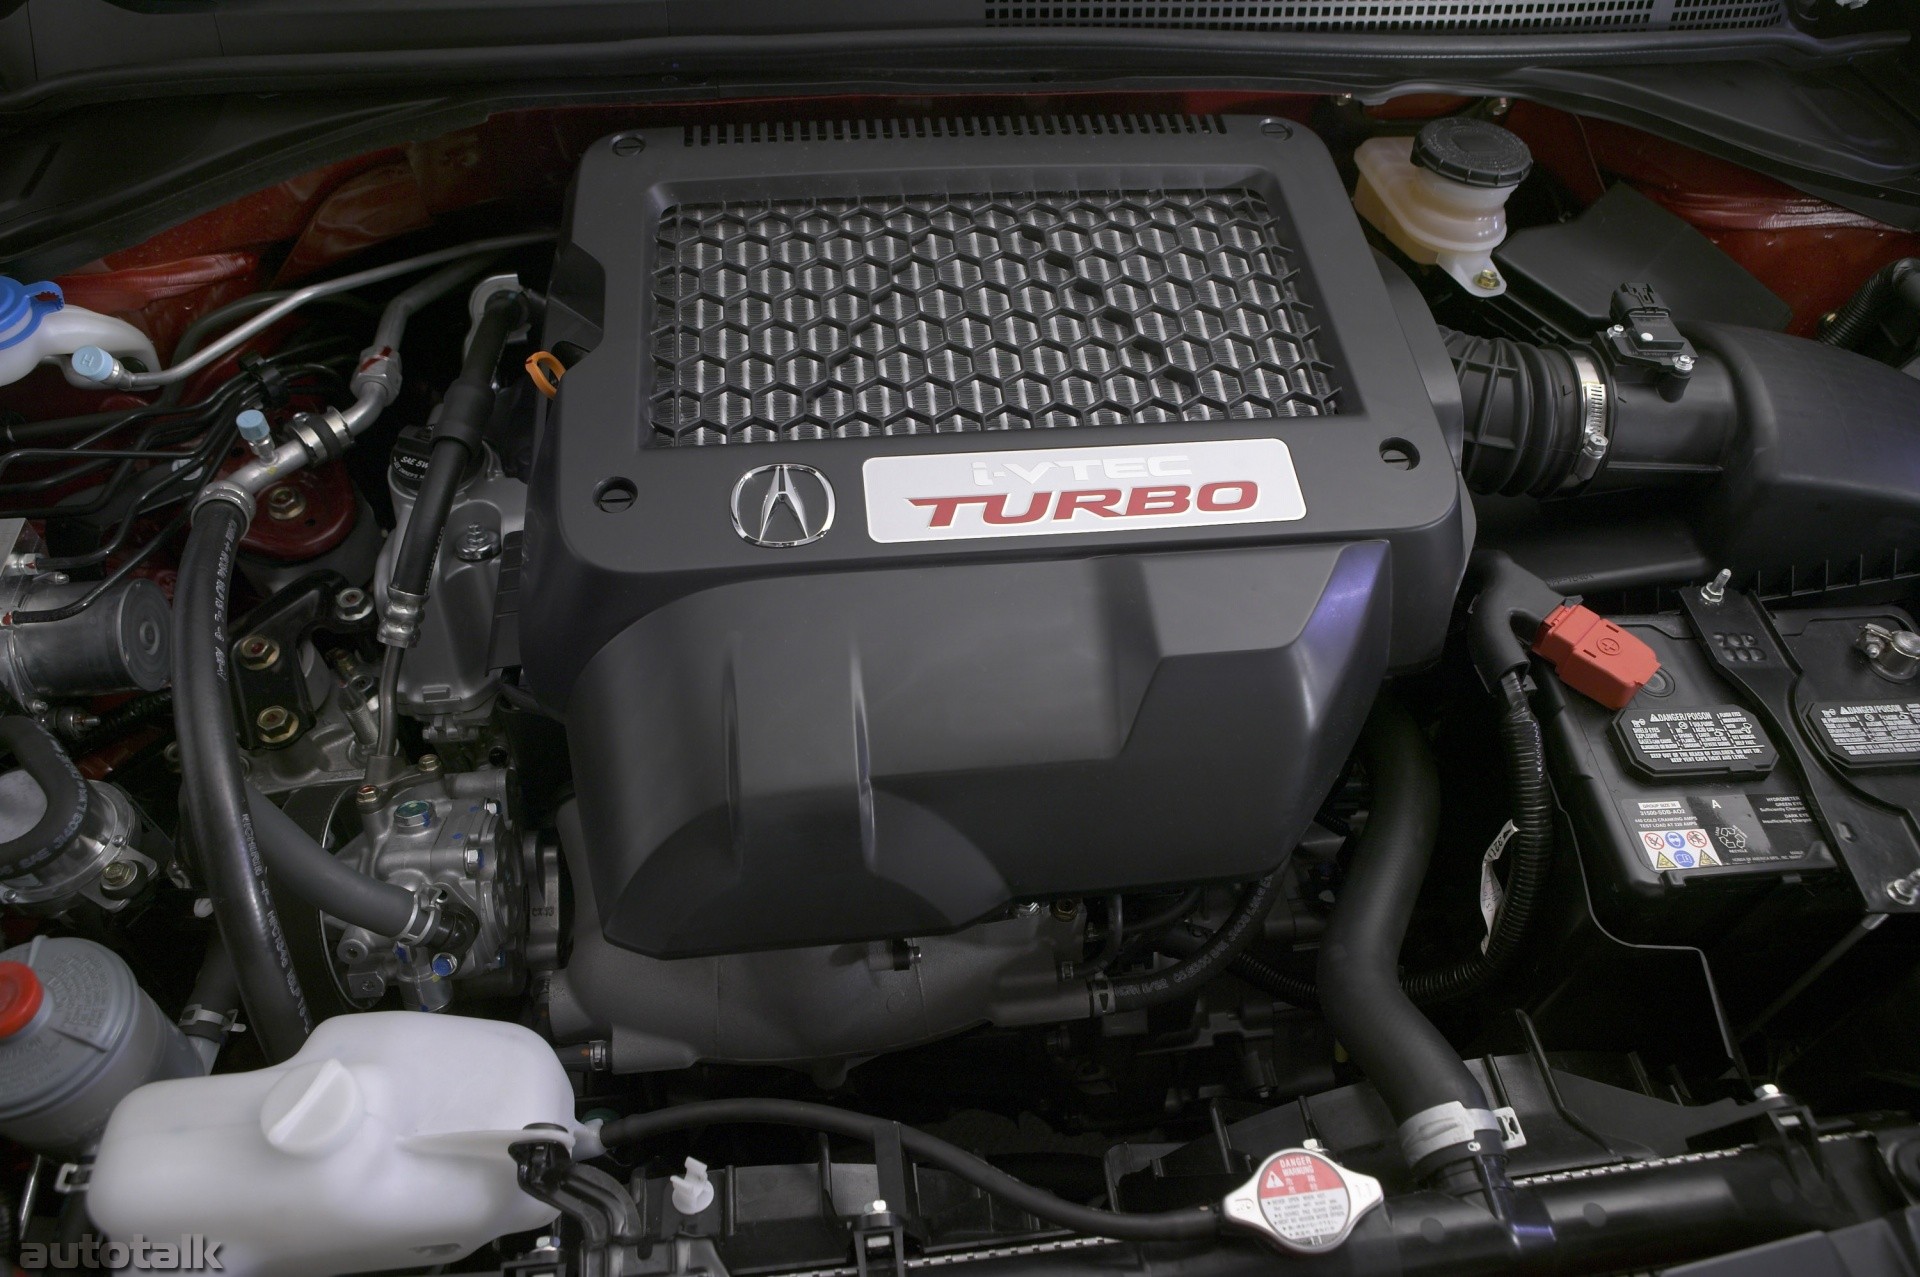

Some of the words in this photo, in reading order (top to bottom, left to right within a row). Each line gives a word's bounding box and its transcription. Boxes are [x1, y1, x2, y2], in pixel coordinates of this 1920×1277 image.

[971, 454, 1192, 486] i-VTEC
[907, 481, 1259, 528] TURBO
[1658, 712, 1712, 721] DANGER/POISON
[1712, 799, 1722, 809] A
[1279, 1155, 1312, 1169] DANGER
